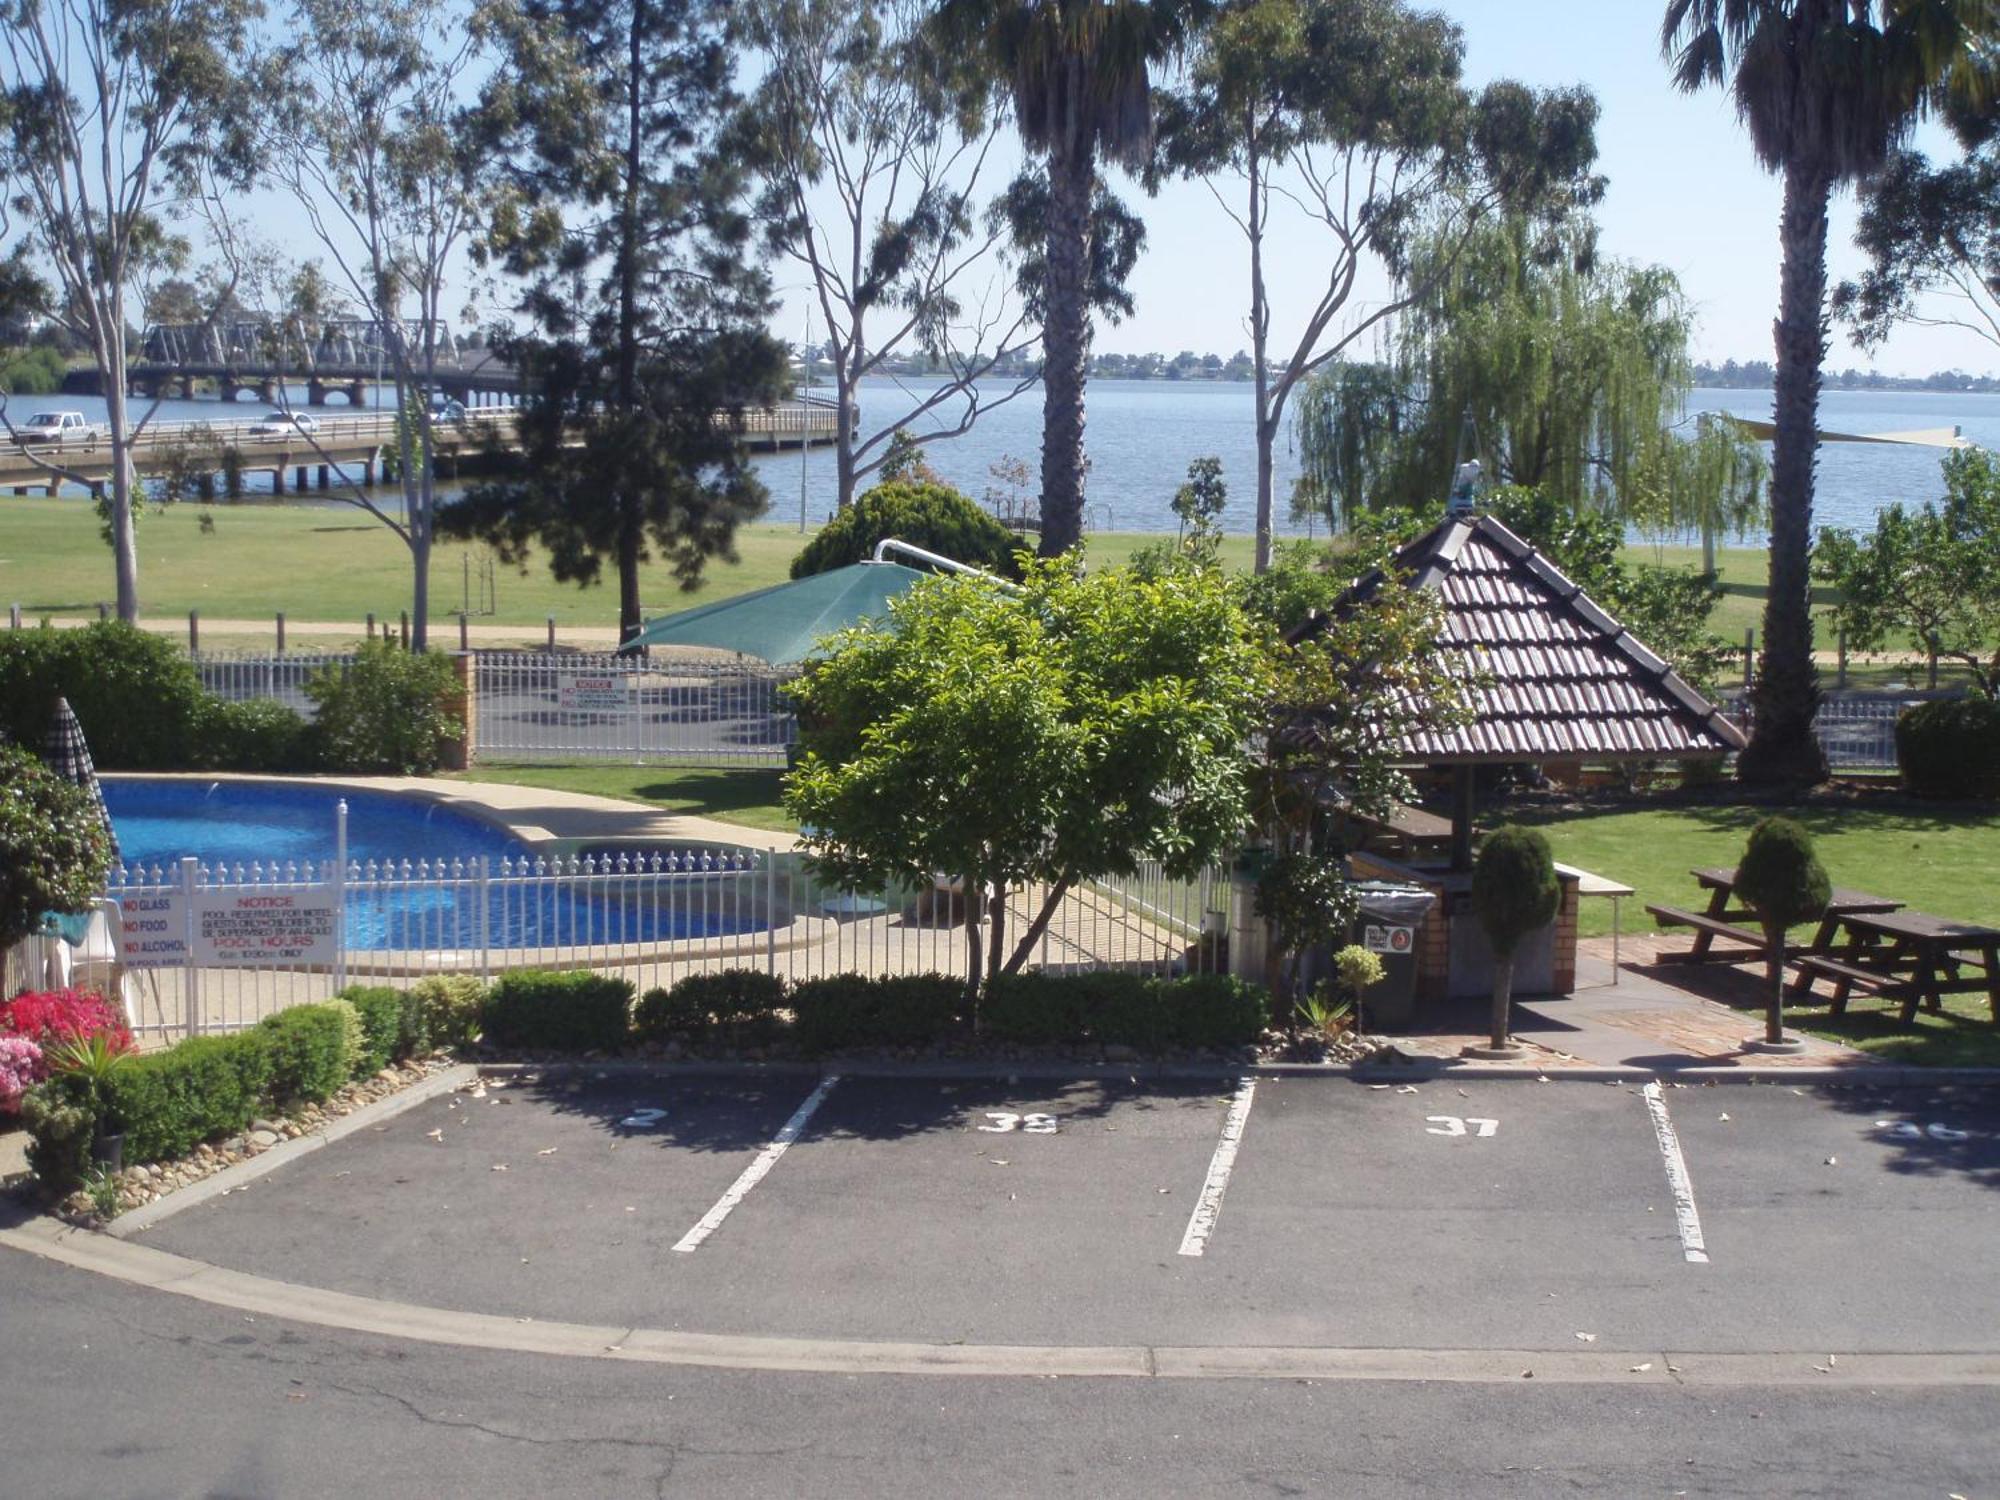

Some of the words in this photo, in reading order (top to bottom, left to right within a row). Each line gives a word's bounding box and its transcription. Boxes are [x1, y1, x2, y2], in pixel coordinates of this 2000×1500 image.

[123, 900, 138, 912] NO
[139, 899, 171, 911] GLASS
[237, 896, 294, 908] NOTICE
[202, 911, 226, 919] POOL
[231, 910, 280, 919] RESERVED
[282, 909, 301, 918] FOR
[303, 908, 332, 917] MOTEL
[123, 920, 138, 932] NO
[139, 919, 168, 932] FOOD
[202, 919, 238, 928] GUESTS
[315, 917, 327, 926] TO
[202, 929, 214, 938] BE
[217, 928, 273, 938] SUPERVISED
[124, 941, 139, 953] NO
[140, 940, 187, 952] ALCOHOL
[213, 938, 257, 948] POOL
[261, 936, 314, 948] HOURS
[279, 949, 304, 958] ONLY
[620, 1108, 669, 1127] 2
[976, 1112, 1057, 1134] 38
[1424, 1116, 1500, 1137] 37
